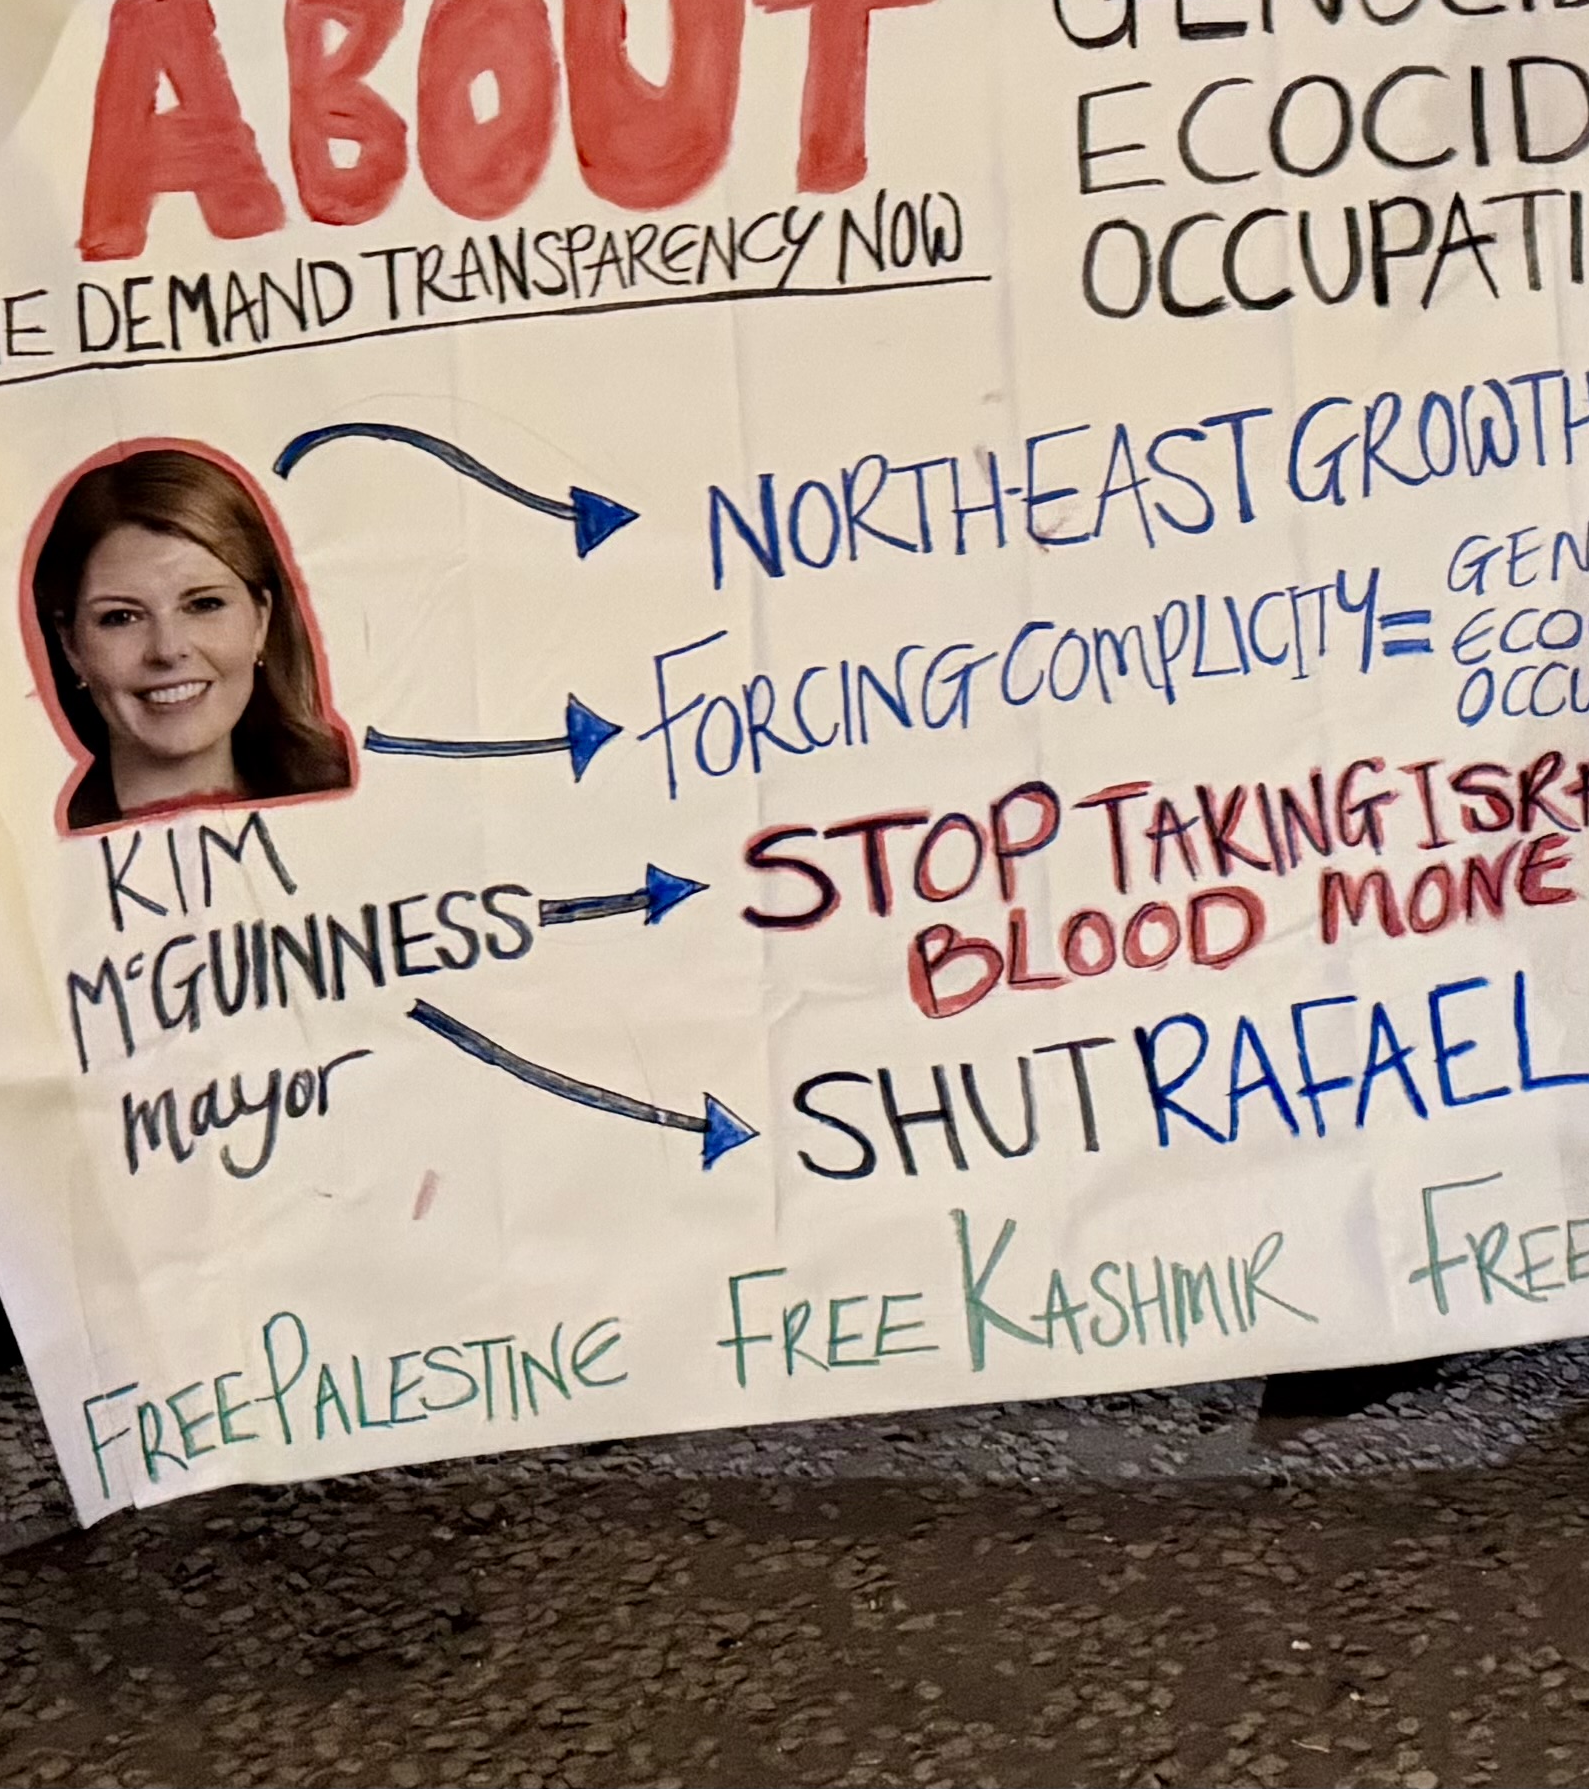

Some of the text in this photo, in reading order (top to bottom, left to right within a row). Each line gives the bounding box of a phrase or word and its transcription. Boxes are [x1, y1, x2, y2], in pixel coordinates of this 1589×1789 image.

[78, 259, 354, 355] DEMAND
[360, 204, 825, 319] TRANSPARENCY
[836, 191, 963, 272] NOW
[636, 630, 1000, 799] FORCING
[98, 812, 298, 932] KIM
[742, 780, 1062, 930] STOP
[1074, 760, 1402, 894] TAKING
[906, 888, 1268, 1018] BLOOD
[122, 1048, 374, 1178] mayor
[792, 1037, 1120, 1182] SHUT
